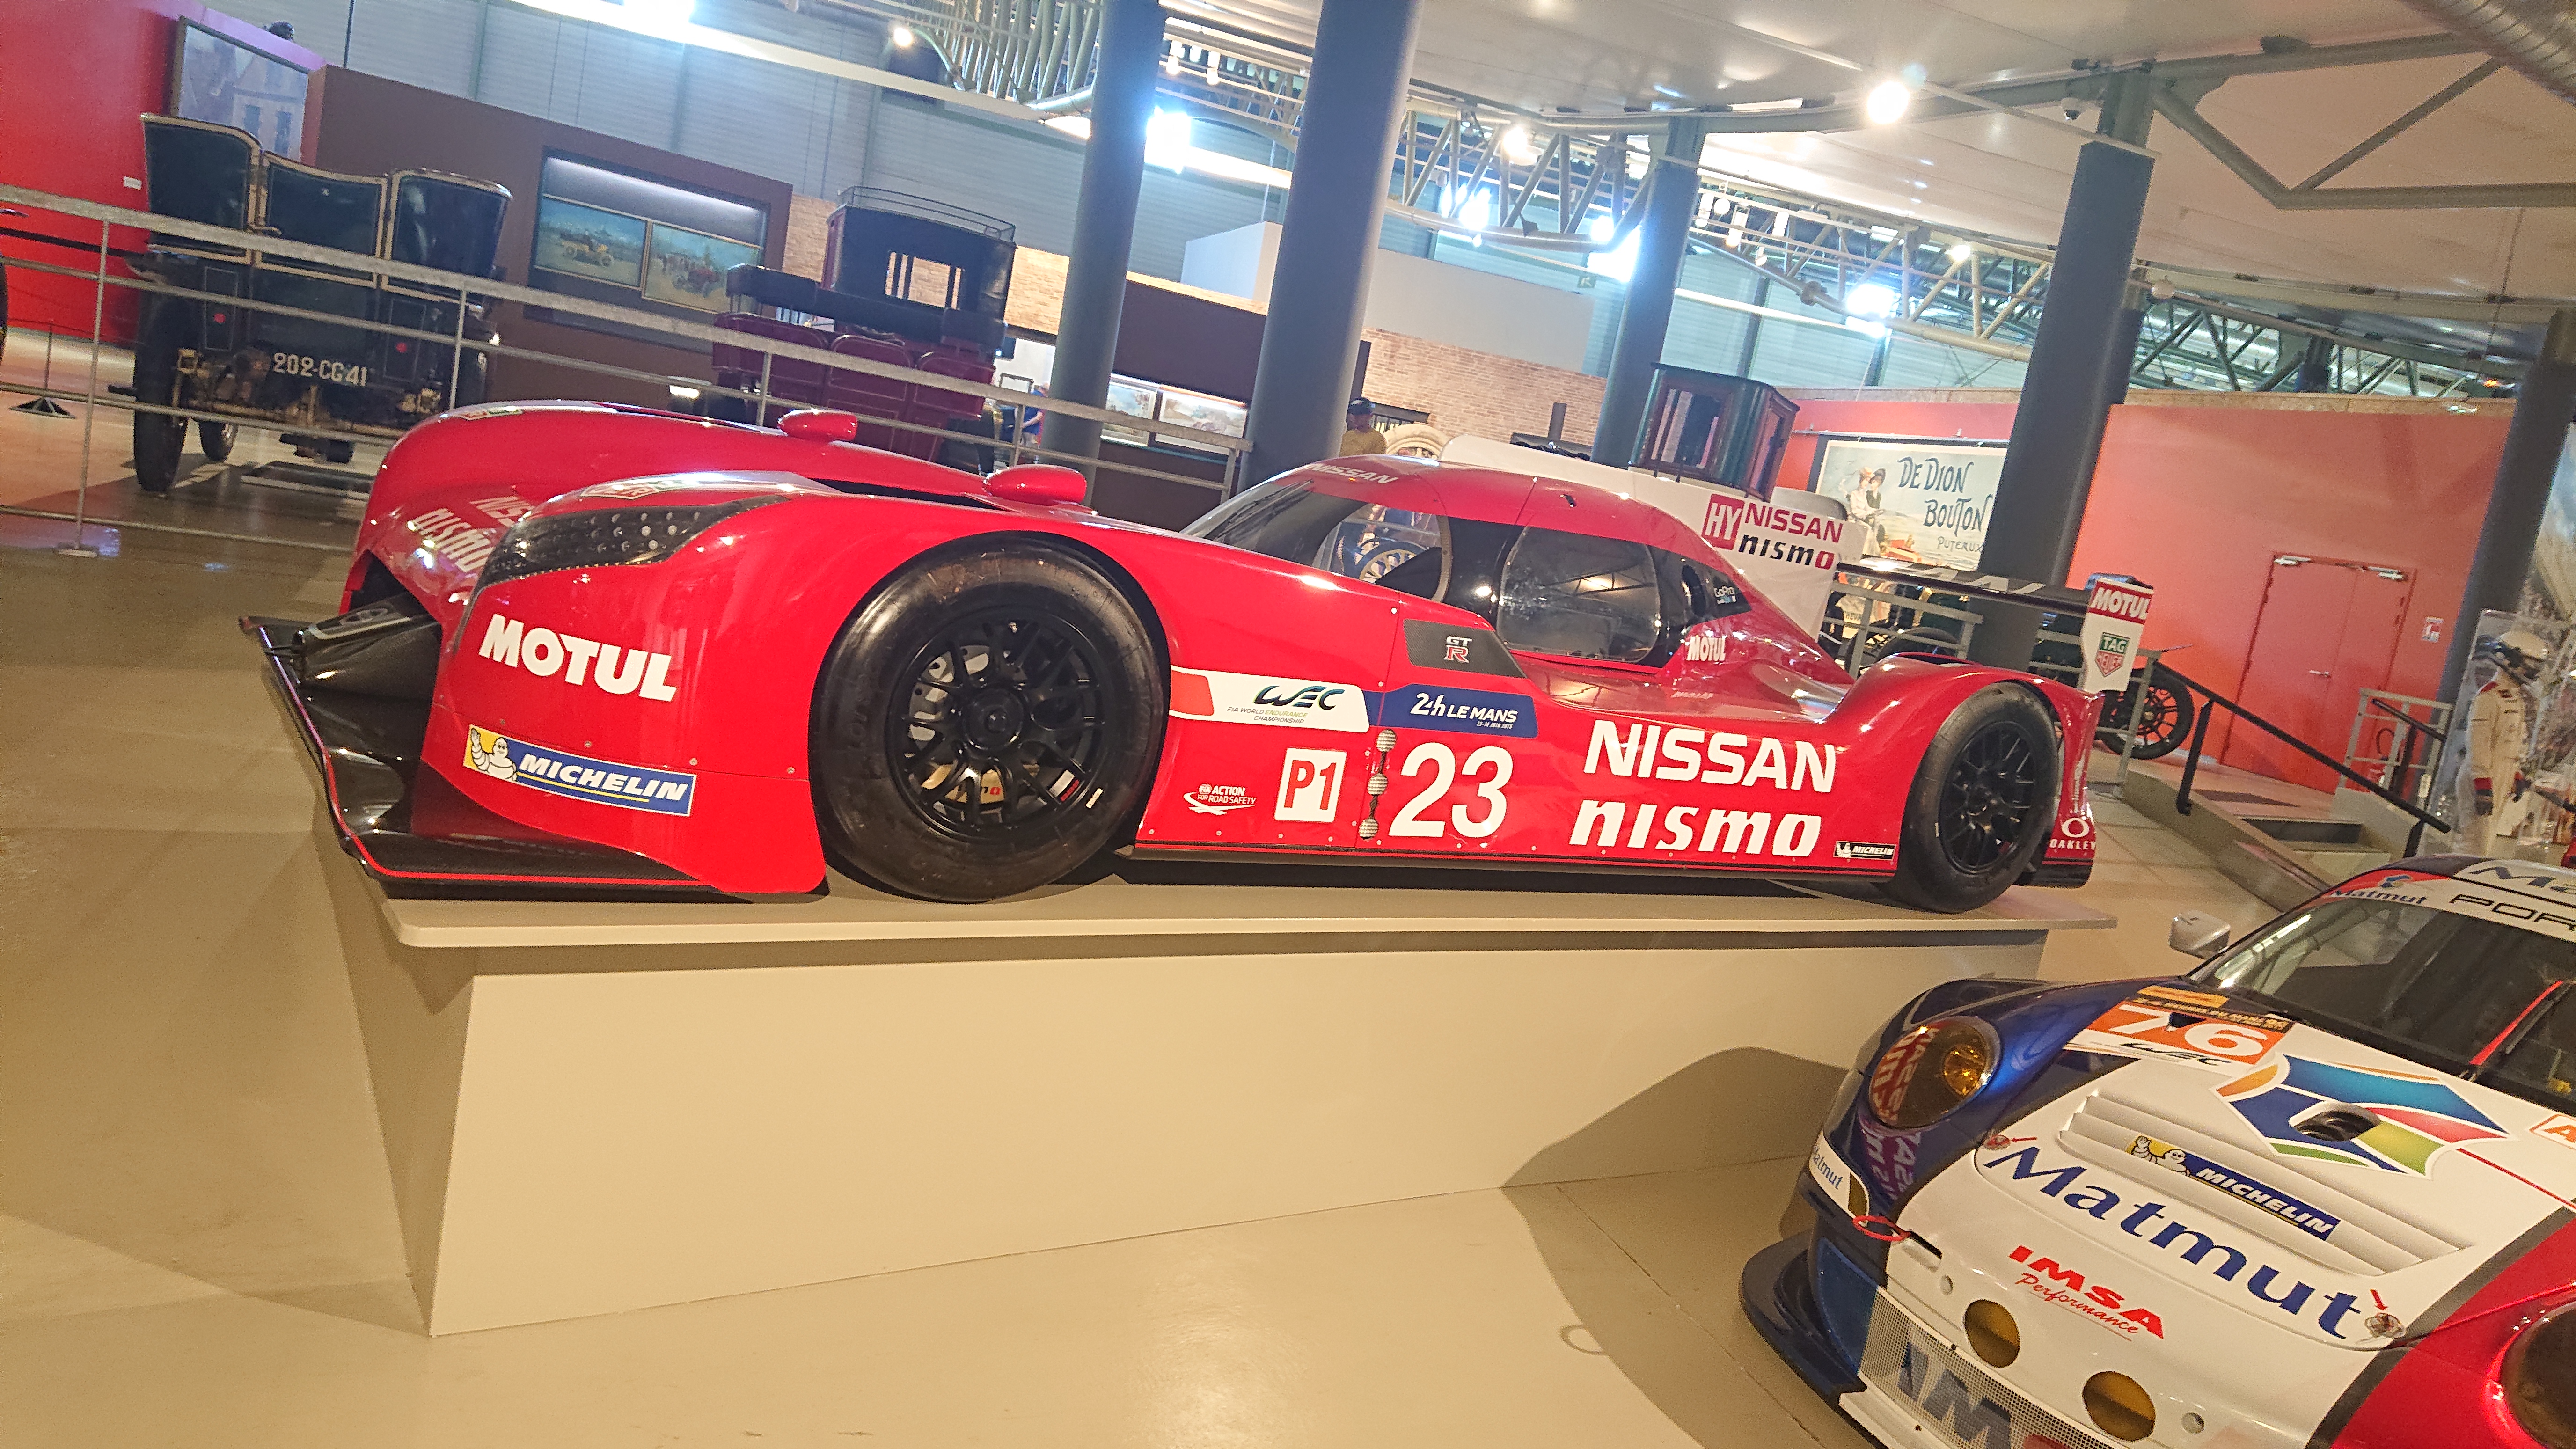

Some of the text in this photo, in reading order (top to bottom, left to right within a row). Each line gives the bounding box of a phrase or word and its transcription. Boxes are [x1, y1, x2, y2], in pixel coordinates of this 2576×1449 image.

[1897, 457, 1974, 492] DE DION
[1705, 502, 1742, 541] HY
[1744, 503, 1844, 543] NISSAN
[1923, 494, 1993, 537] BOUTON
[1738, 534, 1835, 570] nismo
[2091, 587, 2150, 620] MOTUL
[478, 614, 677, 702] MOTUL
[1686, 636, 1726, 661] MOTUL
[2103, 637, 2127, 652] TAG
[1252, 685, 1346, 710] WEC
[1265, 710, 1309, 718] ENDURANCE
[1447, 705, 1470, 719] LE
[1469, 707, 1518, 723] MANS
[1253, 715, 1305, 724] CHAMPIONSHIP
[1583, 719, 1836, 793] NISSAN
[518, 754, 688, 801] MICHELIN
[1212, 785, 1246, 796] ACTION
[1283, 760, 1338, 810] P1
[1389, 742, 1514, 838] 23
[1208, 795, 1229, 804] ROAD
[1229, 796, 1257, 805] SAFETY
[1569, 799, 1822, 857] nismo
[2049, 839, 2096, 850] OAKLEY
[1852, 846, 1895, 856] MICHELIN
[2108, 1004, 2269, 1057] 76
[2195, 1167, 2335, 1234] MICHELIN
[1982, 1146, 2362, 1339] Matmut
[2008, 1245, 2164, 1339] IMSA
[2014, 1273, 2139, 1334] Performance
